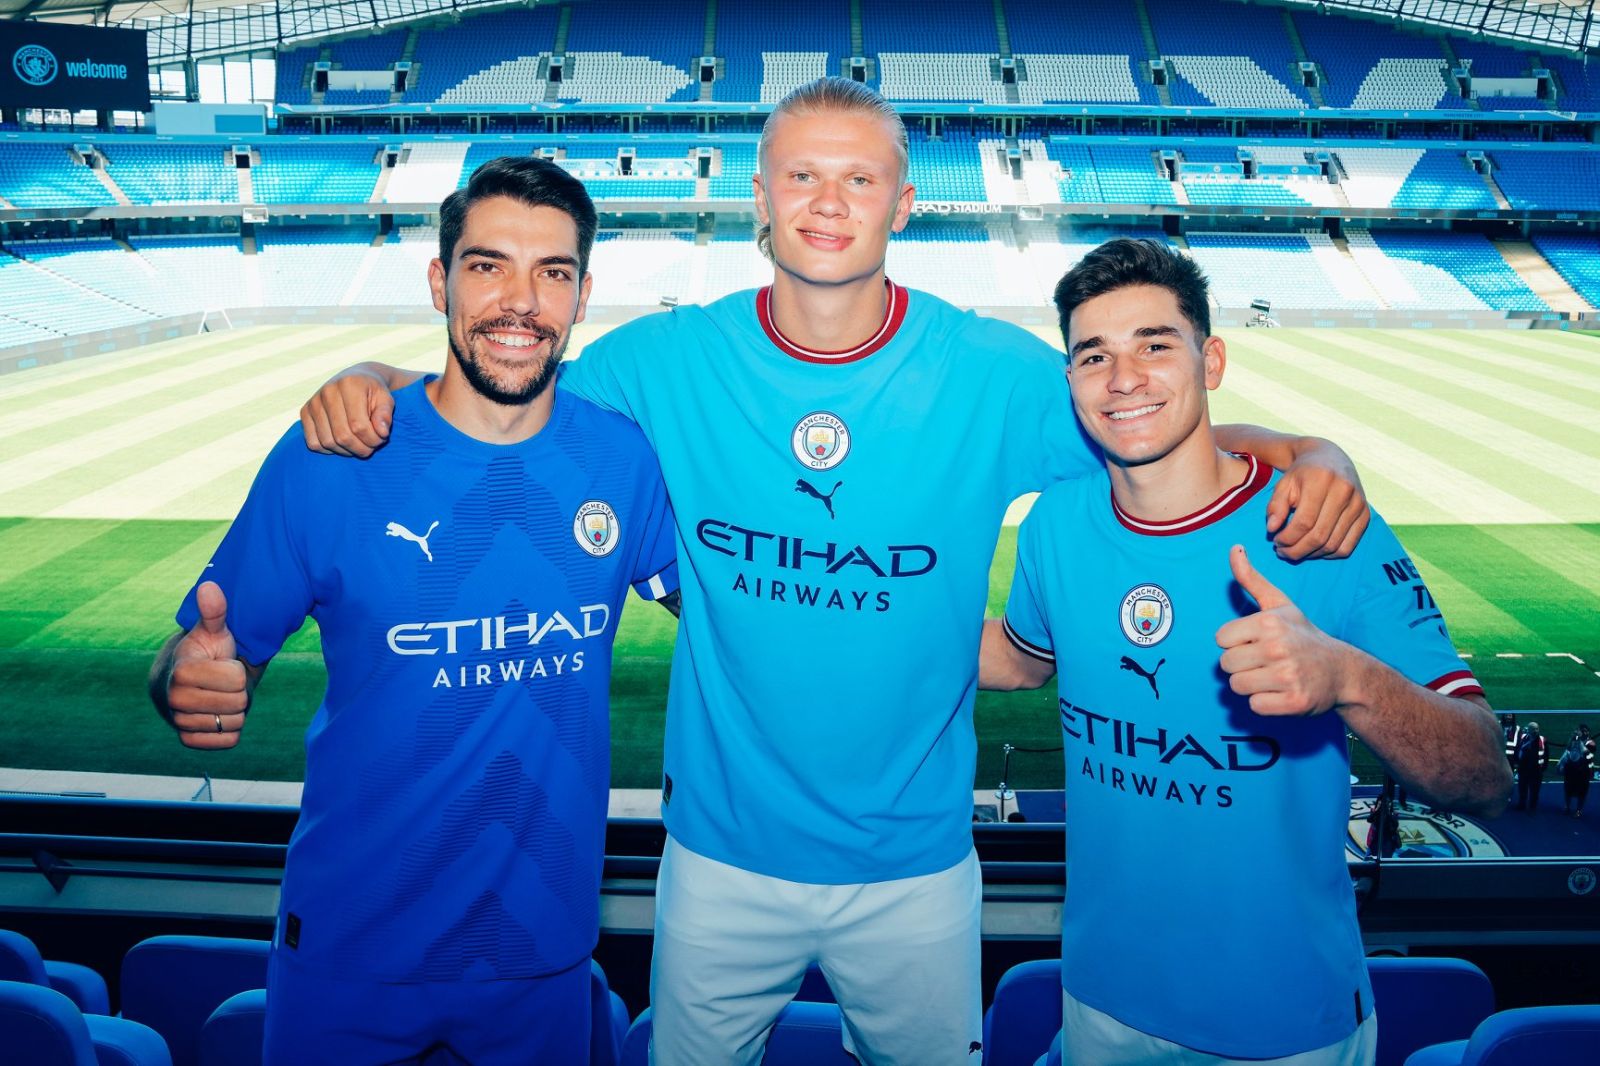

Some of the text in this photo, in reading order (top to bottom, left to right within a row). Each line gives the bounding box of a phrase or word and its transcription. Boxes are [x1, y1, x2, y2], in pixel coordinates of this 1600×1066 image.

[66, 58, 127, 79] welcome
[954, 204, 1001, 213] STADIUM
[798, 415, 846, 436] MANCHESTER
[576, 503, 614, 521] MANCHESTER
[696, 518, 937, 578] ETIHAD
[1382, 558, 1421, 586] NE
[732, 572, 891, 612] AIRWAYS
[1126, 588, 1170, 609] MANCHESTER
[386, 603, 610, 656] ETIHAD
[1136, 636, 1154, 644] CITY
[432, 651, 585, 689] AIRWAYS
[1059, 697, 1281, 772] ETIHAD
[1081, 756, 1233, 808] AIRWAYS
